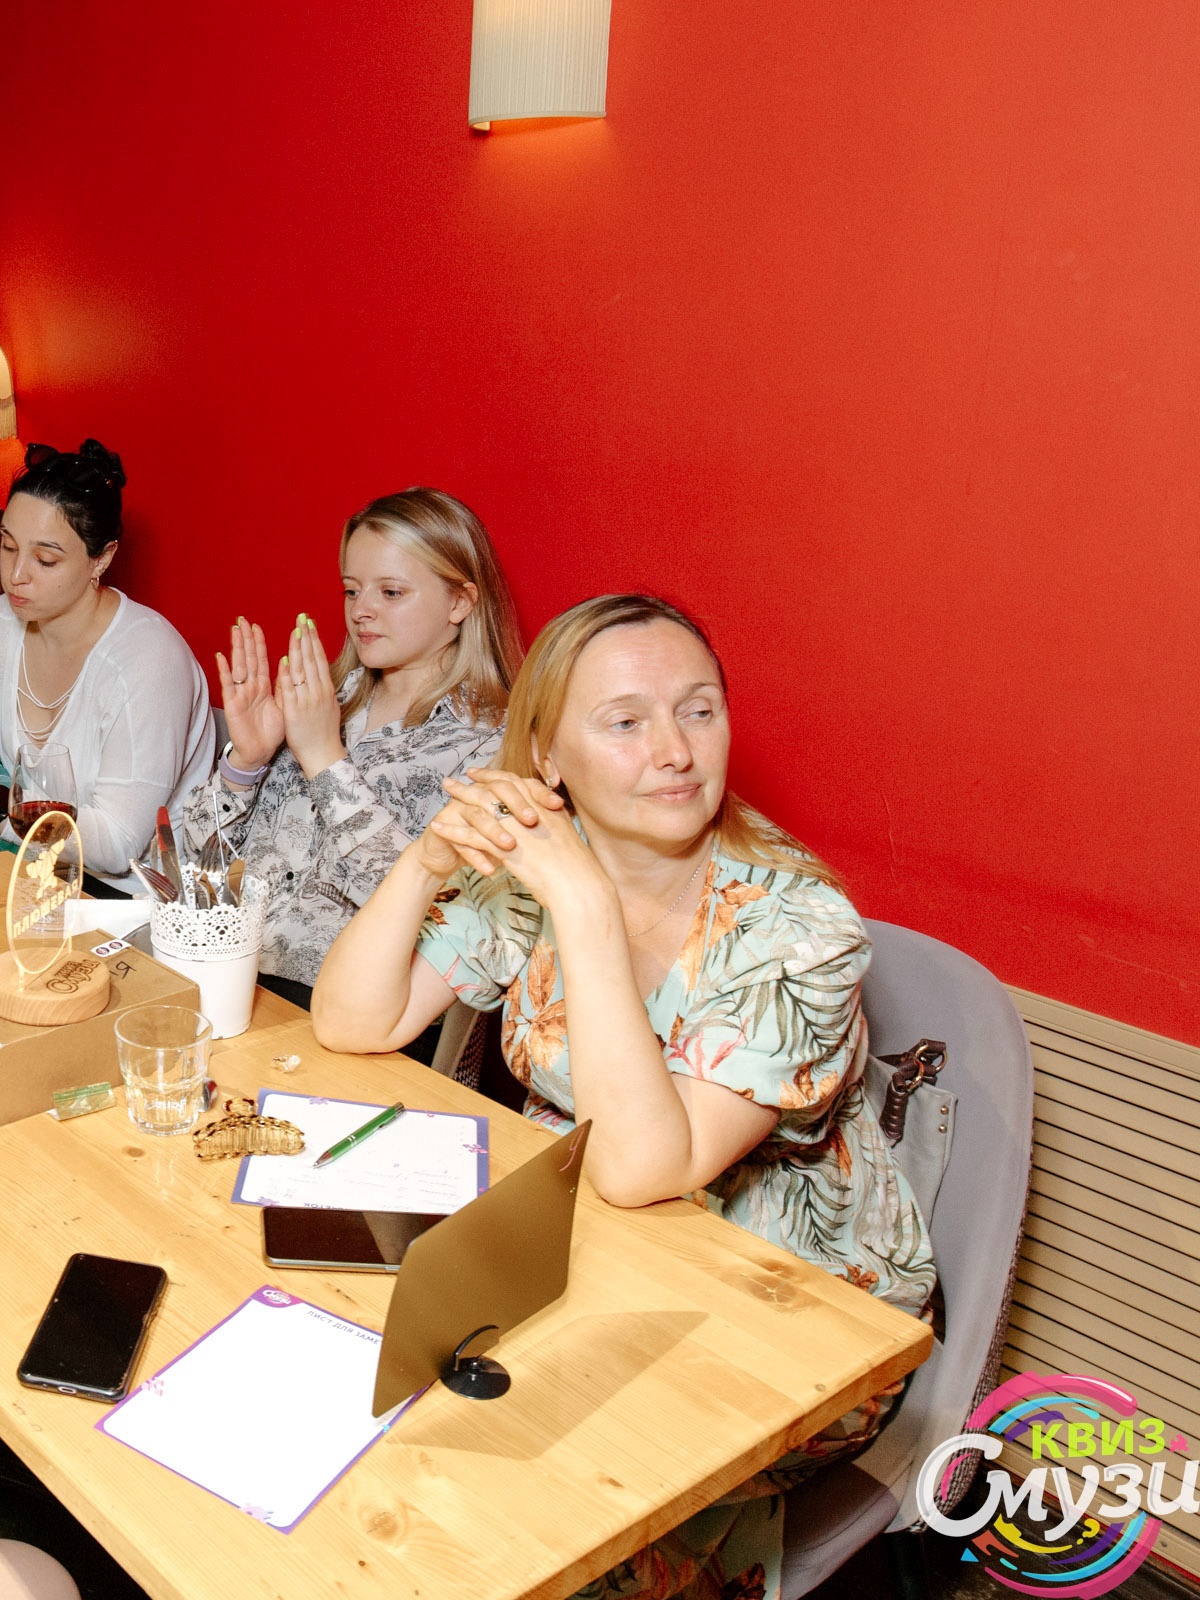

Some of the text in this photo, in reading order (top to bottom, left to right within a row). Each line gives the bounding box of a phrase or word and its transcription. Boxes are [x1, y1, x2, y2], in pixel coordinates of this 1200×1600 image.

[306, 1310, 380, 1345] ЛИСТ ДЛЯ ЗАМЕ
